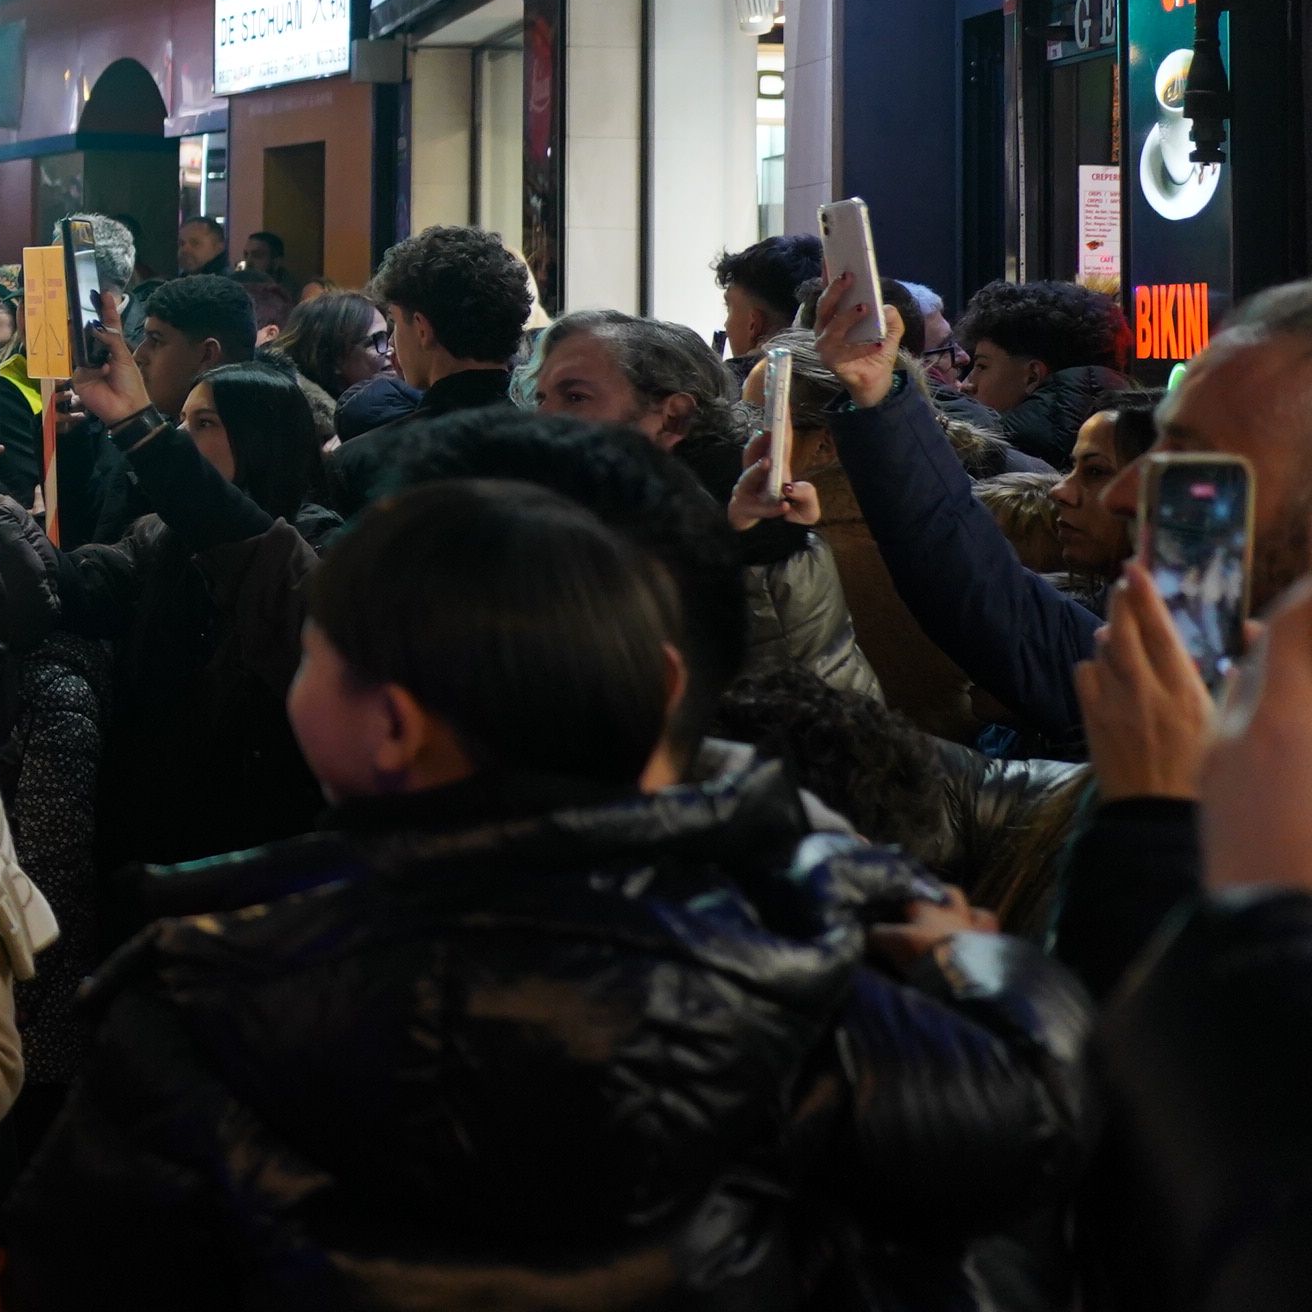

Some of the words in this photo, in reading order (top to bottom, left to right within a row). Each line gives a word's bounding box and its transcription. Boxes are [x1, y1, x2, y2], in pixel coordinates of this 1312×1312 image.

[220, 16, 235, 46] DE
[241, 0, 303, 42] SICHUAN
[1136, 282, 1209, 360] BIKINI
